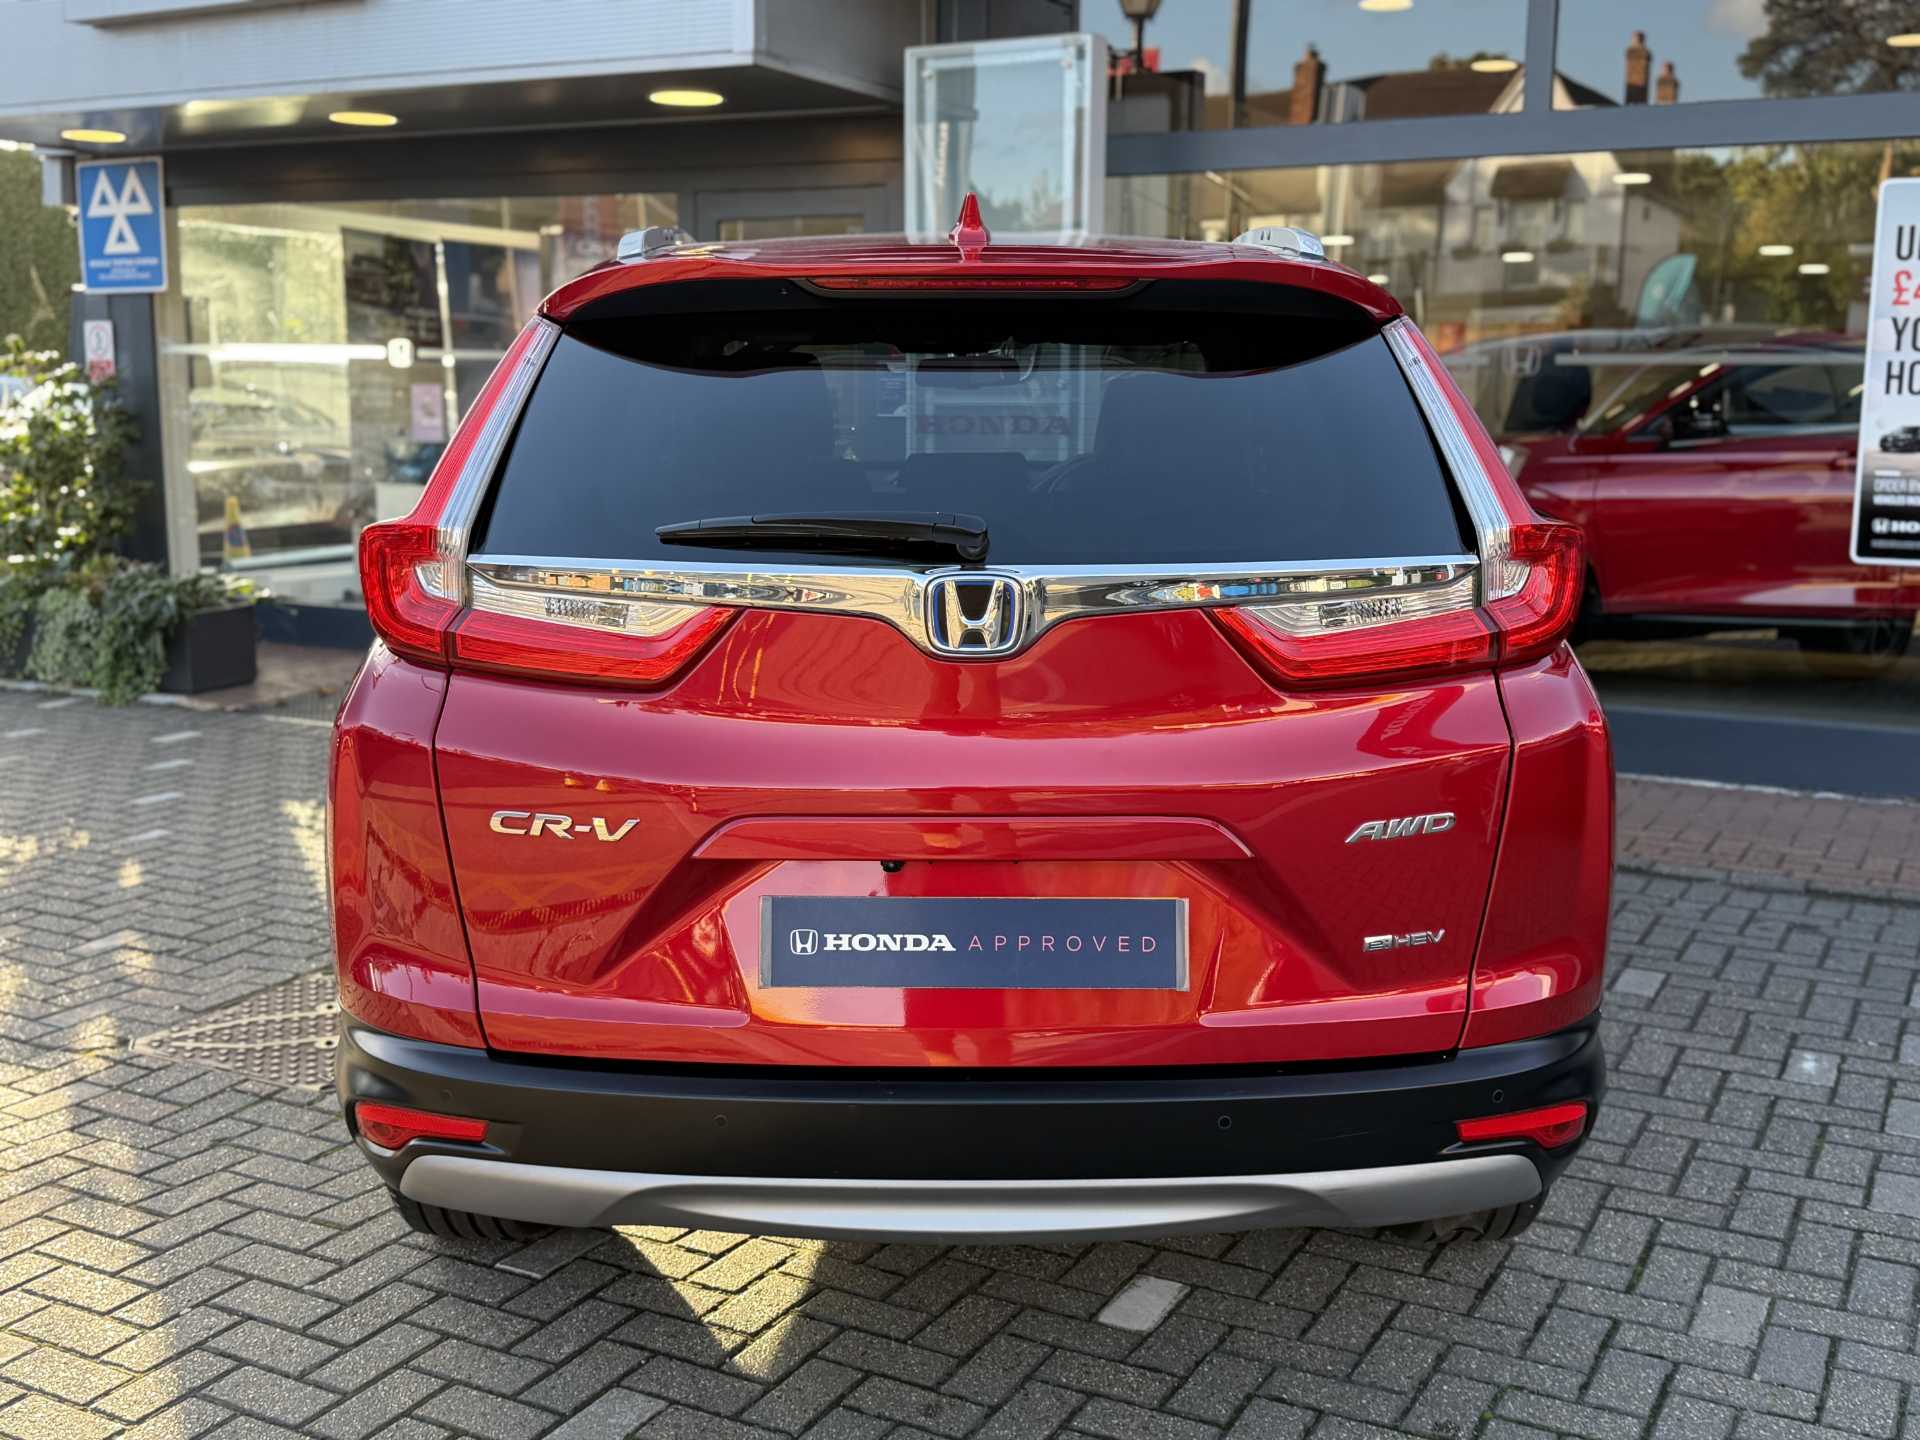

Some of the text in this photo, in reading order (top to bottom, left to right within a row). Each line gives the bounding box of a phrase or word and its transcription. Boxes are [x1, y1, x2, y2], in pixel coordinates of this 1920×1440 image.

[1884, 359, 1920, 396] HO
[489, 809, 641, 842] CR-V
[1344, 811, 1456, 844] AWD
[823, 933, 956, 952] HONDA
[968, 935, 1157, 953] APPROVED
